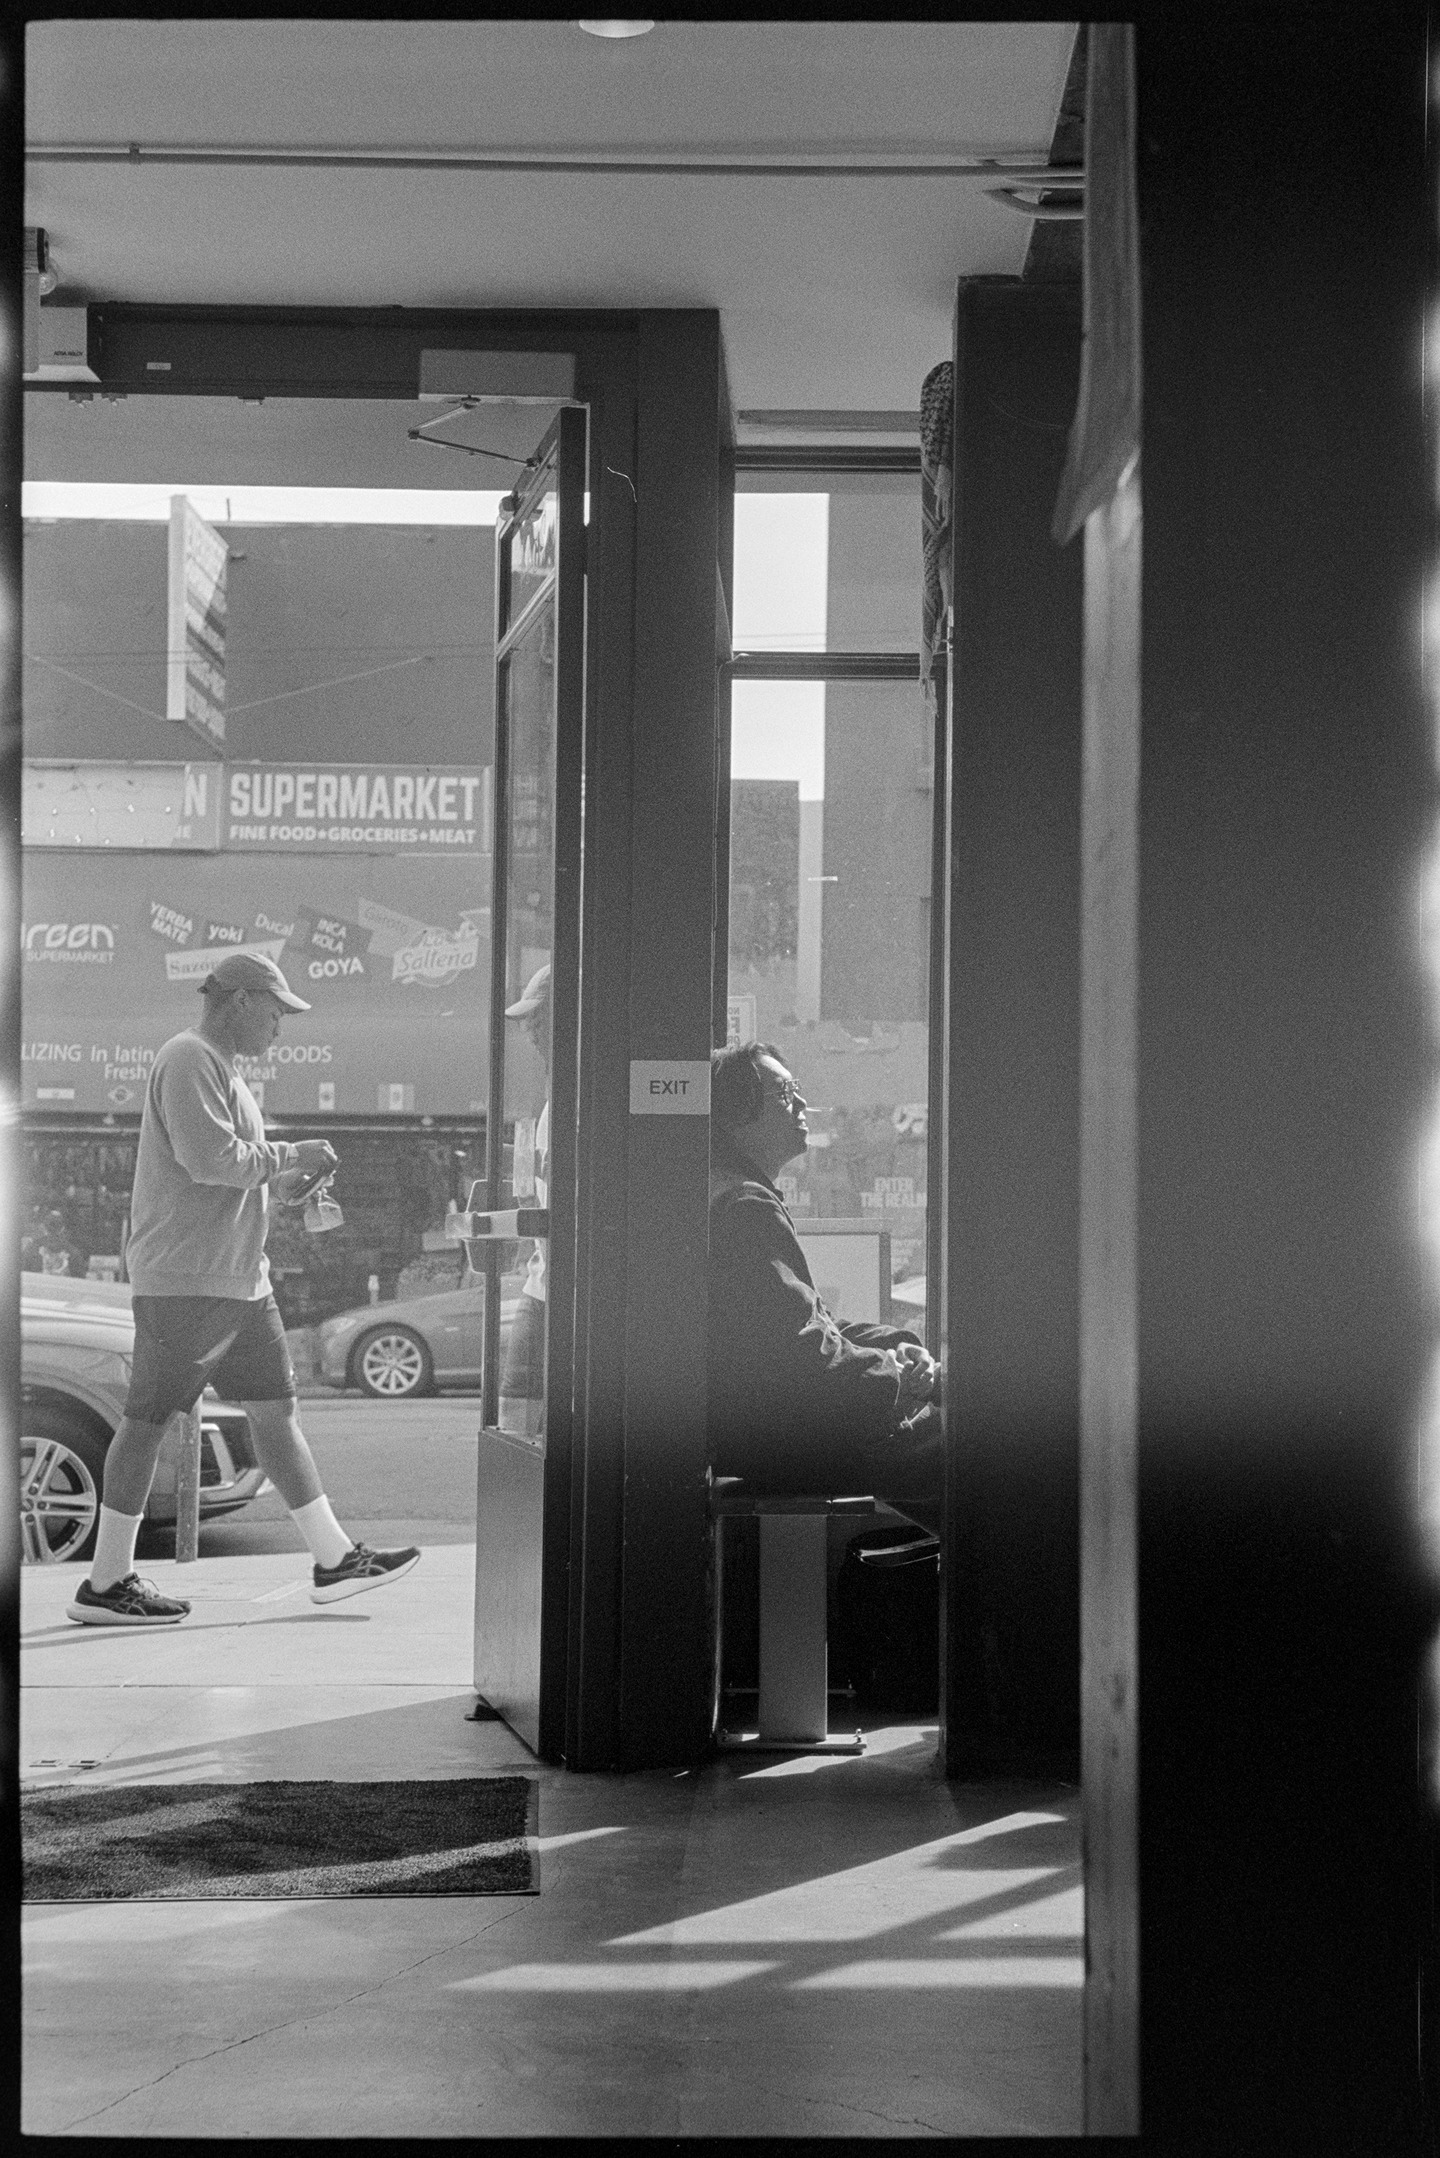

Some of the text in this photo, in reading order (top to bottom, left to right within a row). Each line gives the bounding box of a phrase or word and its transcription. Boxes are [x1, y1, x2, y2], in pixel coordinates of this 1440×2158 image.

[229, 772, 480, 821] SUPERMARKET
[229, 825, 267, 840] FINE
[327, 827, 418, 843] GROCERIES
[429, 829, 477, 844] MEAT
[150, 901, 193, 932] YERBA
[254, 913, 295, 936] Ducal
[151, 918, 189, 945] MATE
[208, 924, 243, 943] yoki
[311, 931, 343, 954] KOLA
[26, 951, 115, 963] SUPERMARKET
[308, 956, 364, 979] GOYA
[115, 1044, 154, 1063] latin
[267, 1045, 332, 1063] FOODS
[104, 1063, 276, 1080] Fresh Meat
[650, 1080, 690, 1095] EXIT
